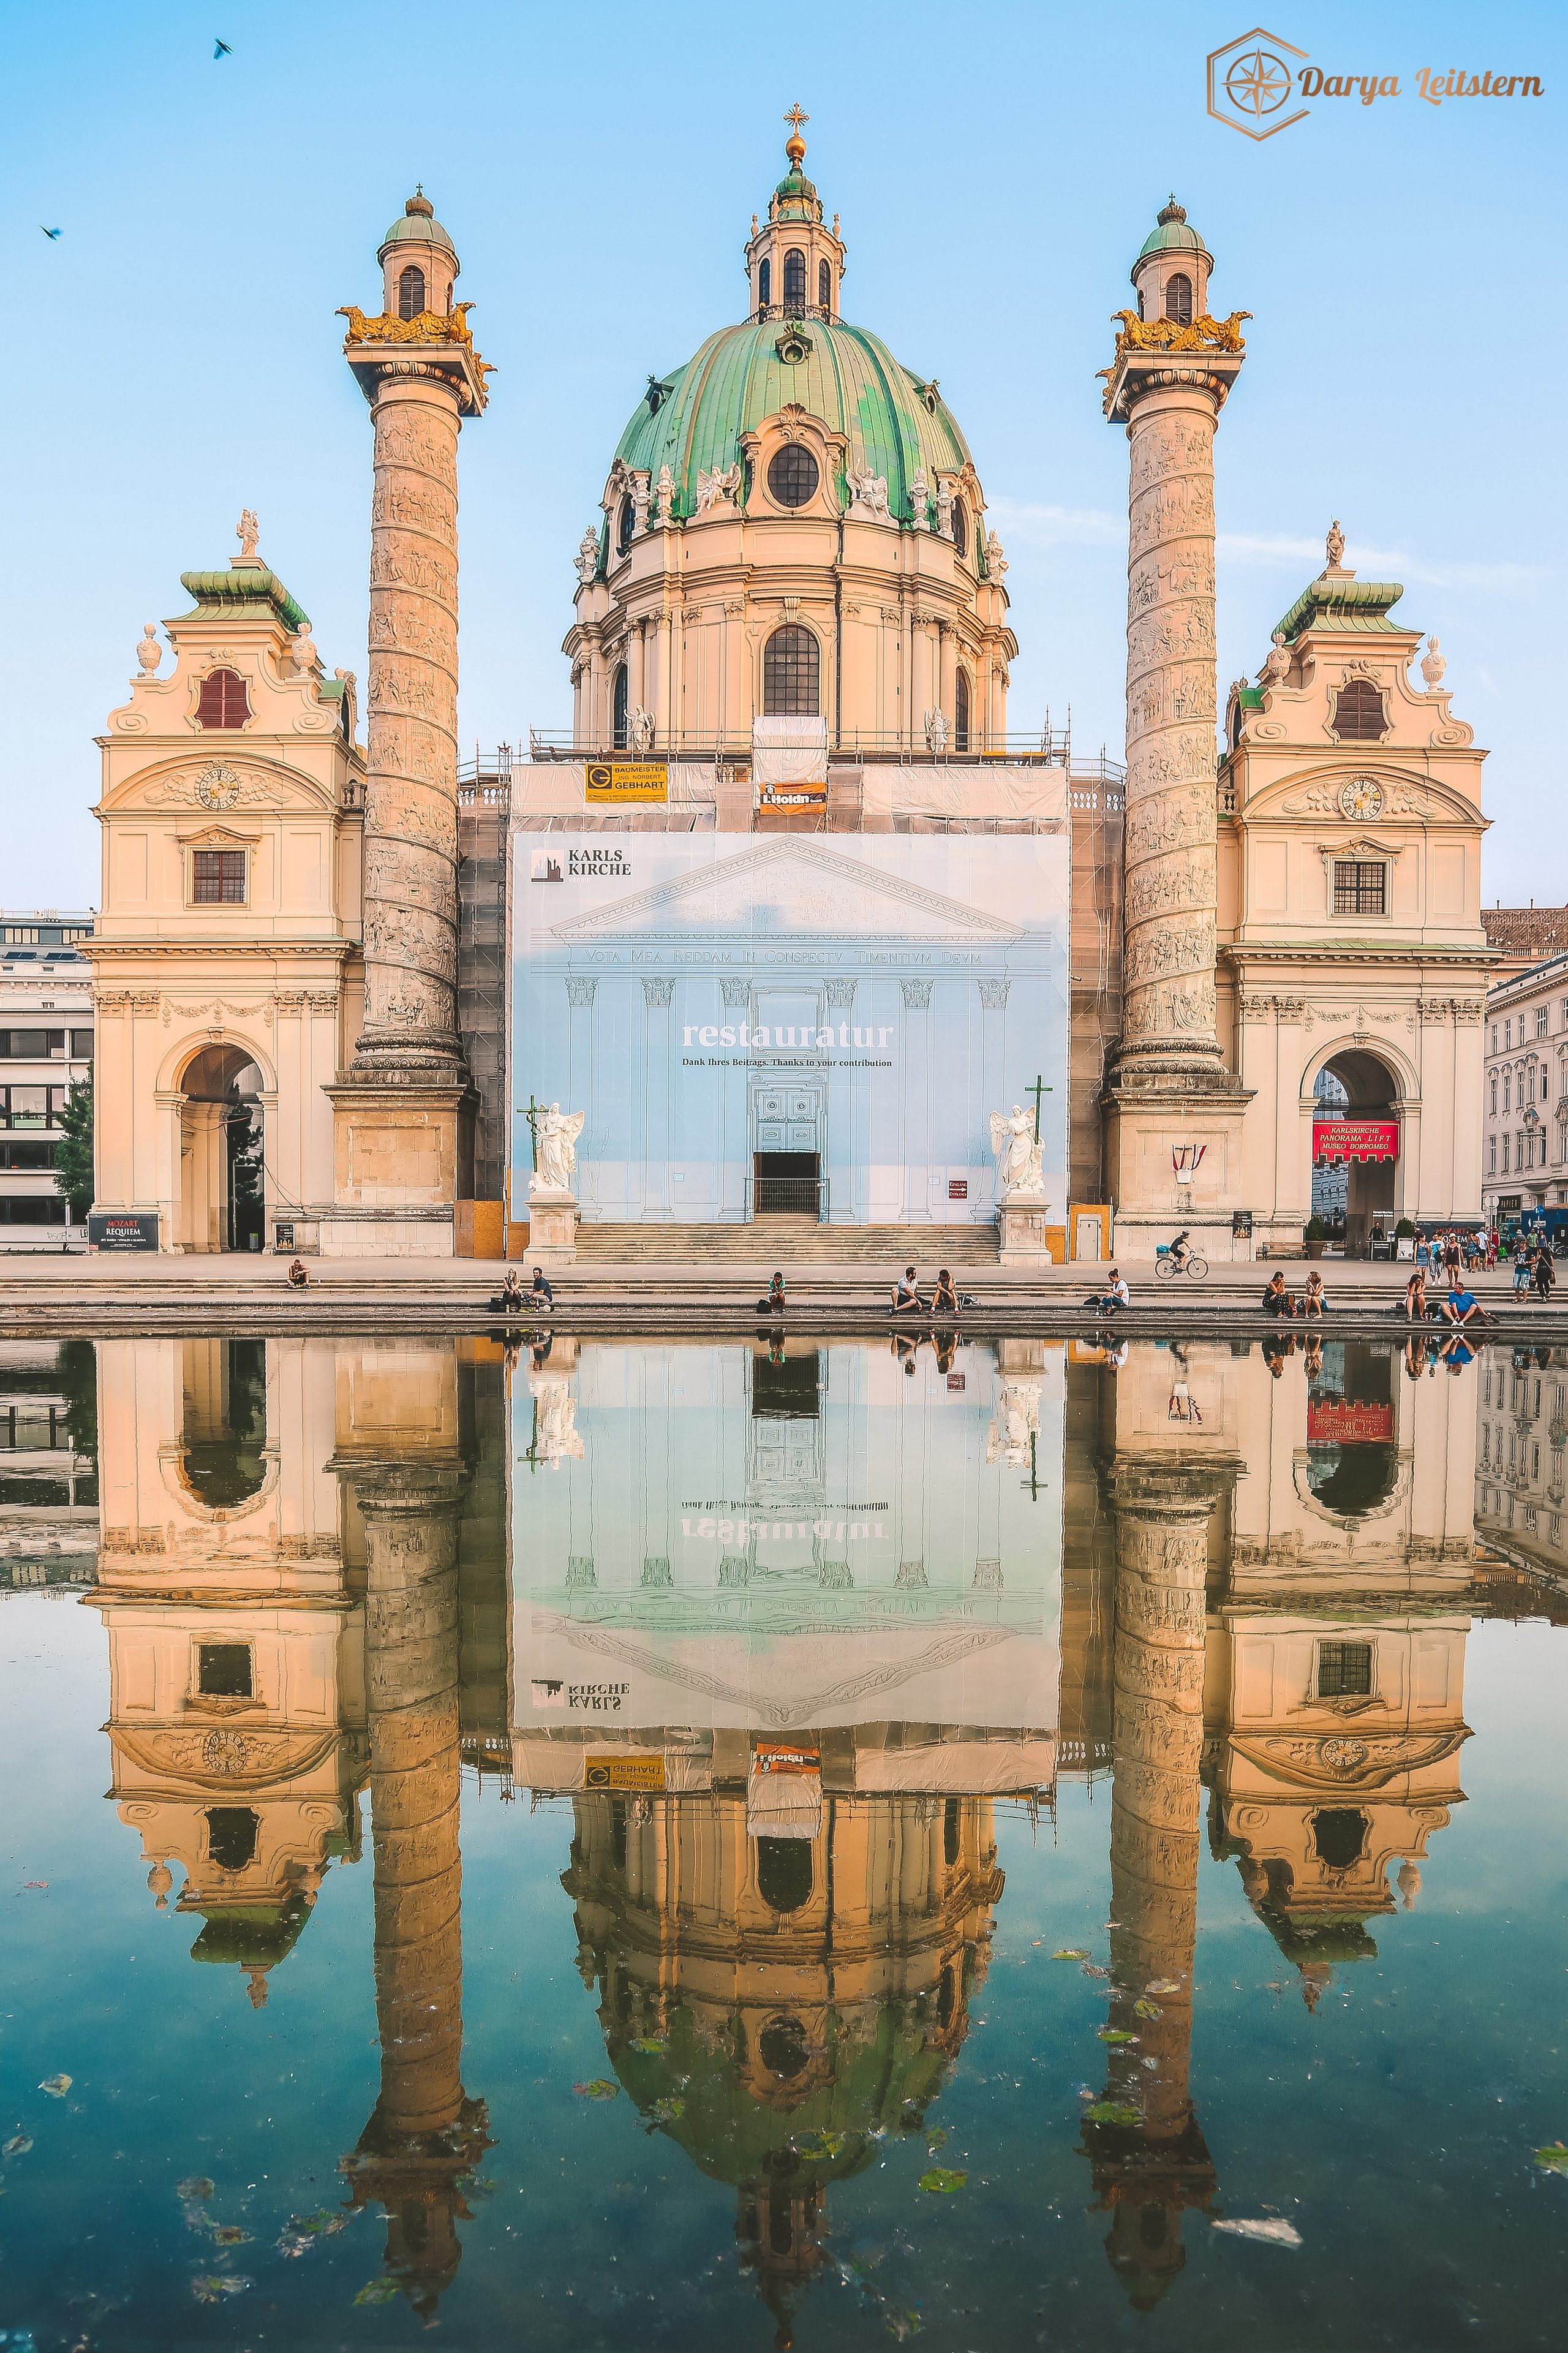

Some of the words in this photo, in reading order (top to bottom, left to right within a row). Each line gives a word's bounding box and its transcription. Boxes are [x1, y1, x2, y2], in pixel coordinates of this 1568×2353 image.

[568, 850, 622, 862] KARLS
[568, 863, 631, 875] KIRCHE
[584, 949, 622, 962] VOTA
[631, 949, 663, 962] MEA
[673, 949, 733, 962] REDDAM
[742, 949, 755, 962] IN
[681, 1020, 894, 1048] restauratur
[682, 1057, 706, 1066] Dank
[708, 1057, 729, 1066] Ihres
[732, 1057, 769, 1068] Beitrags.
[839, 1059, 892, 1067] contribution
[106, 1228, 141, 1237] REQUIEM
